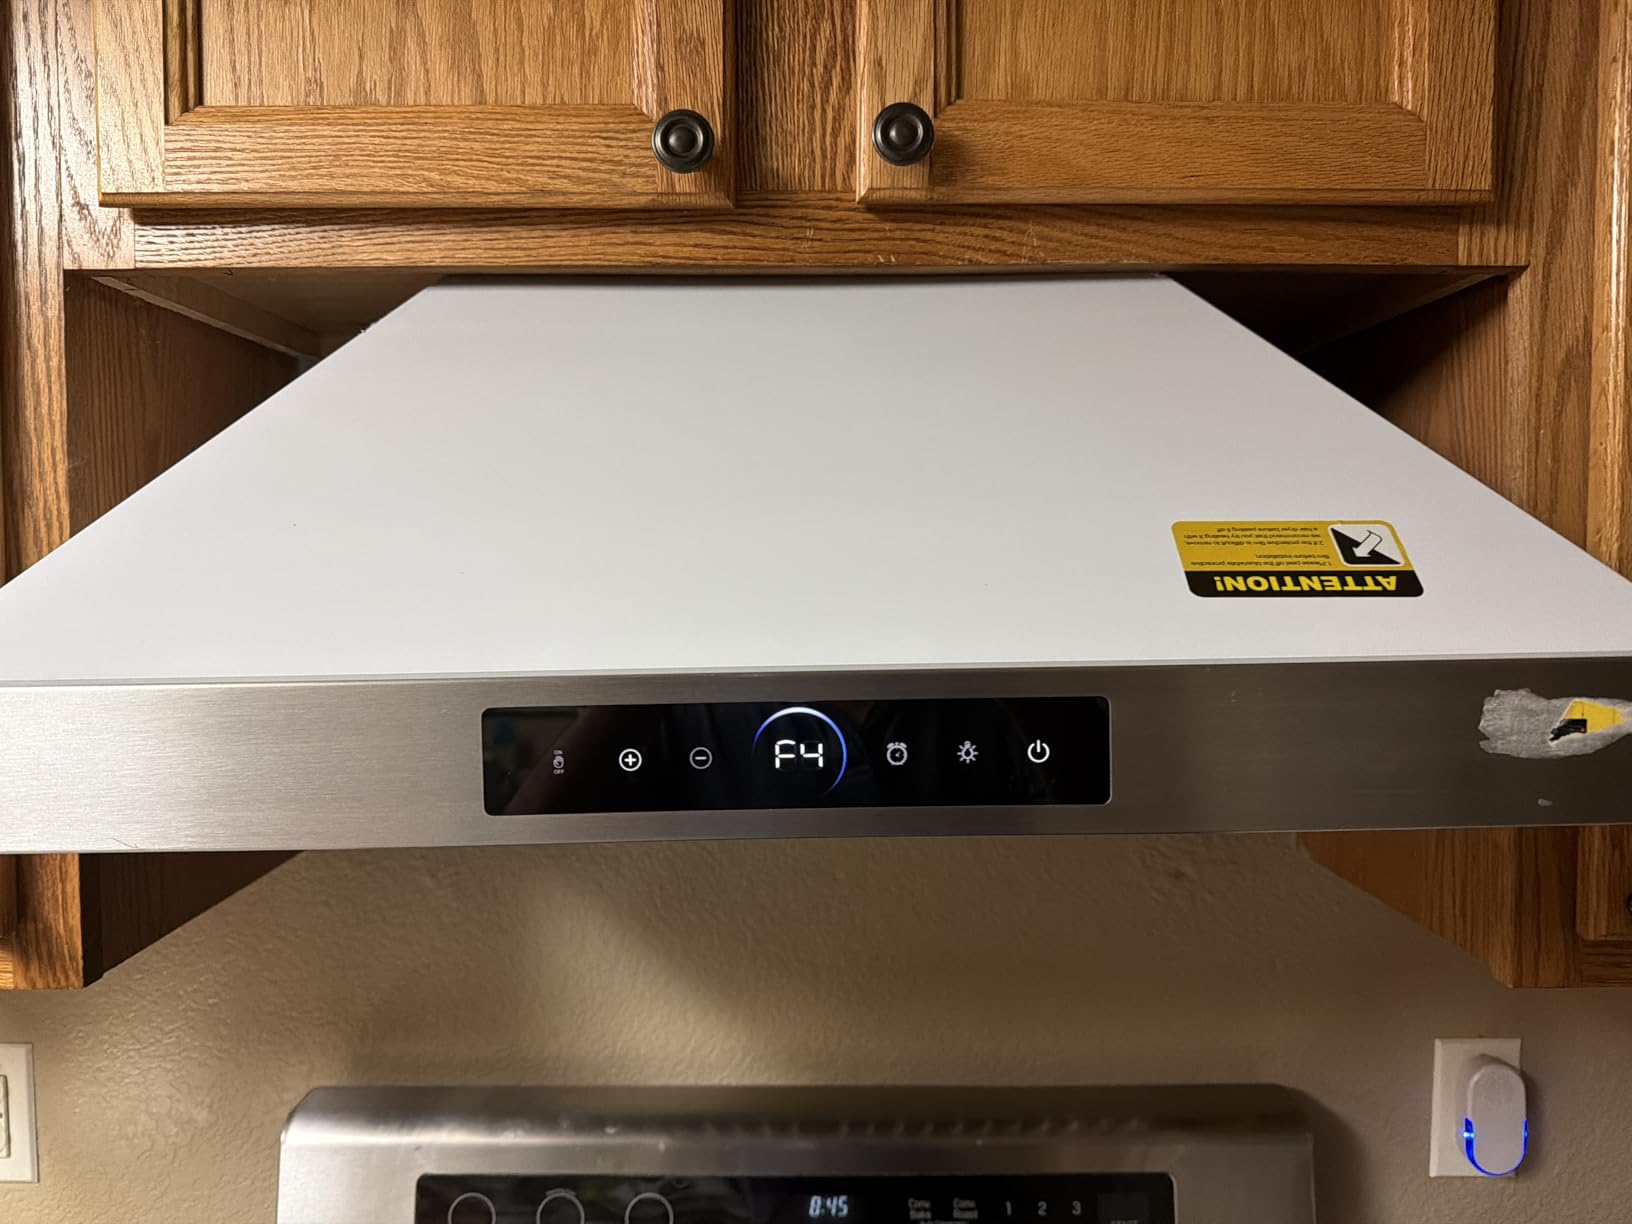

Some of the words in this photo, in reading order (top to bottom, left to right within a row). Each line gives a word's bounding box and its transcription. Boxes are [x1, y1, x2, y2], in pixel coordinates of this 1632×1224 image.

[1213, 576, 1397, 591] ATTENTION!
[775, 740, 824, 769] F4
[1005, 1200, 1012, 1216] 1
[1037, 1200, 1048, 1216] 2
[1071, 1200, 1082, 1216] 3
